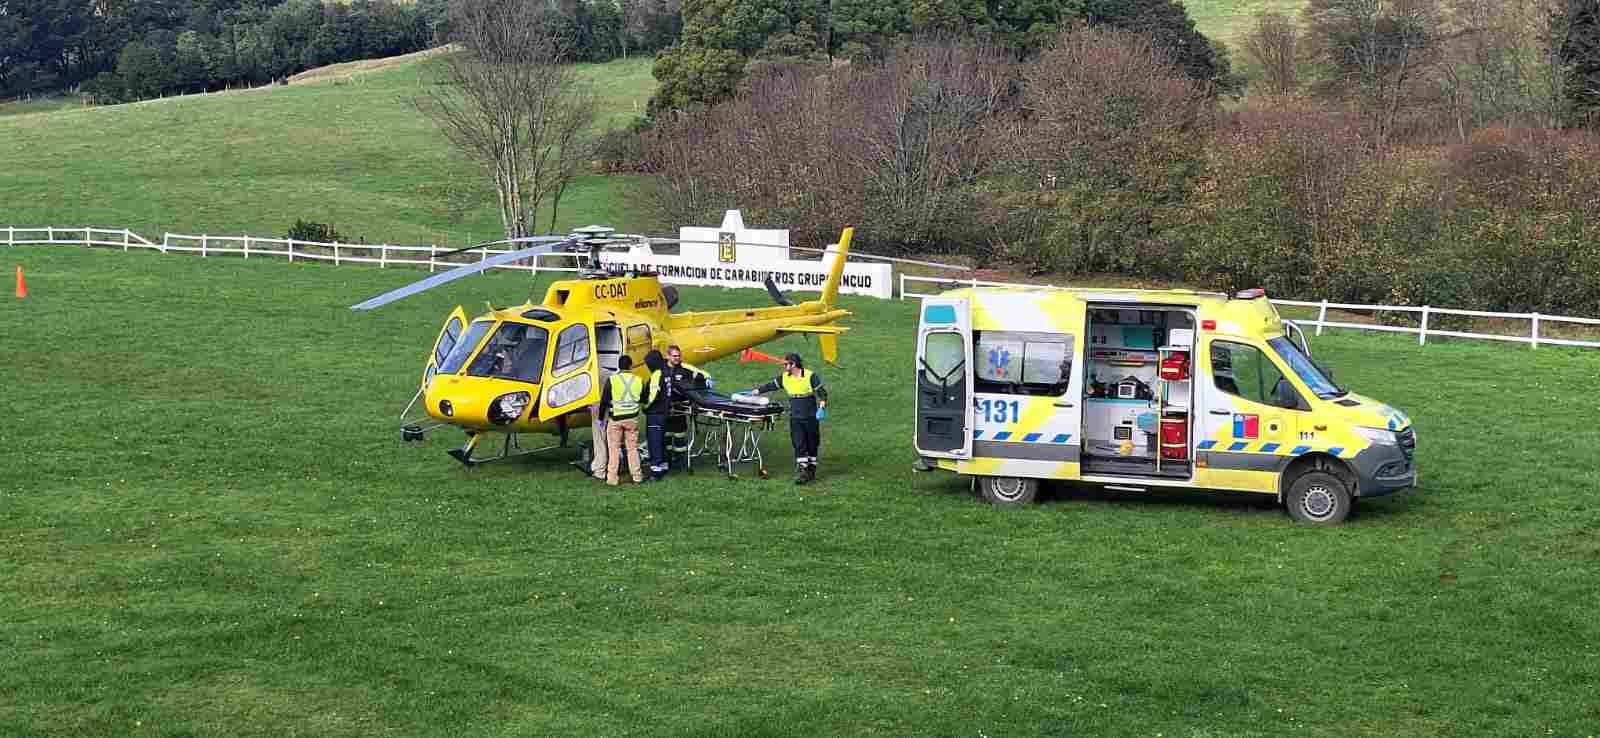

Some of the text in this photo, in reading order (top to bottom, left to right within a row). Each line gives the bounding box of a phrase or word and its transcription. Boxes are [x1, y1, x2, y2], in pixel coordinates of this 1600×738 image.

[598, 262, 639, 272] SCUELA
[656, 264, 707, 279] FORMACION
[710, 267, 722, 280] DE
[839, 274, 872, 288] NCUD
[595, 282, 627, 299] CC-DAT
[982, 399, 1019, 424] 131
[1299, 431, 1314, 441] 111
